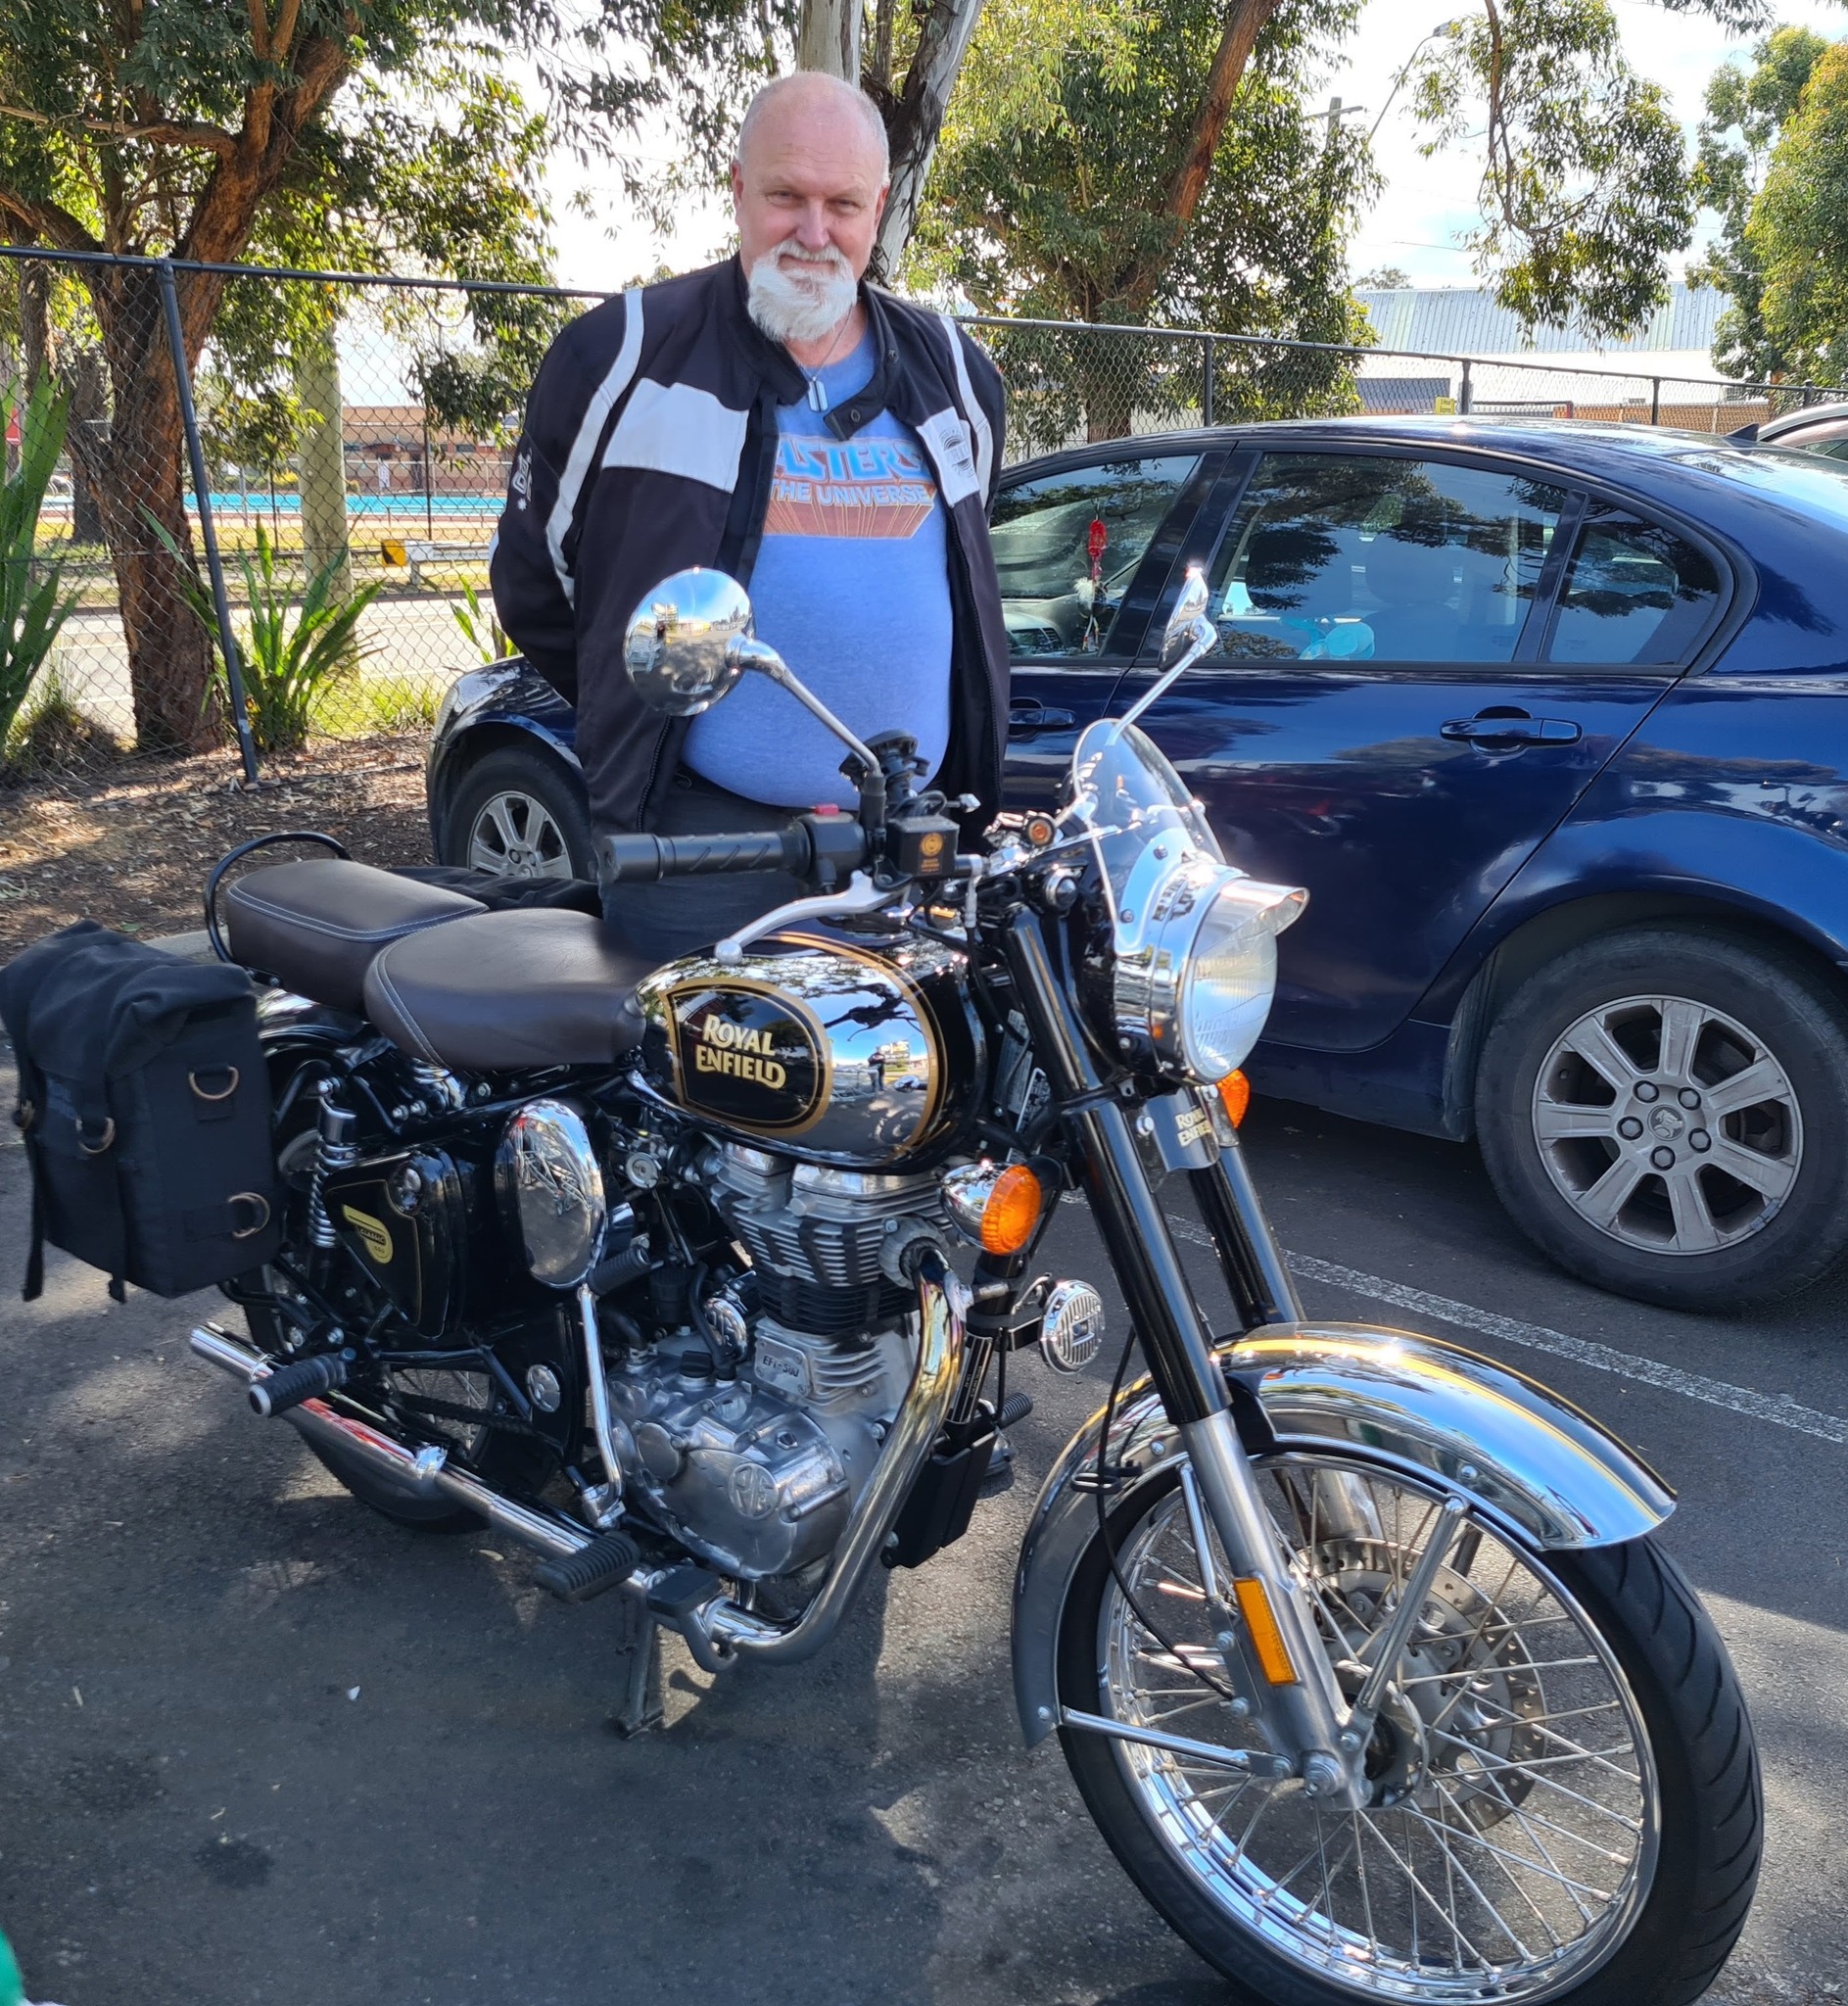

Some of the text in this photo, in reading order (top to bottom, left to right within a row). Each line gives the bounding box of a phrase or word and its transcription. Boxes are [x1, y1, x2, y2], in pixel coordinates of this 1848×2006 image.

[775, 438, 932, 482] ASTERS
[770, 479, 932, 506] THE UNIVERSE
[702, 1014, 776, 1056] ROYAL
[696, 1044, 786, 1089] ENFIELD
